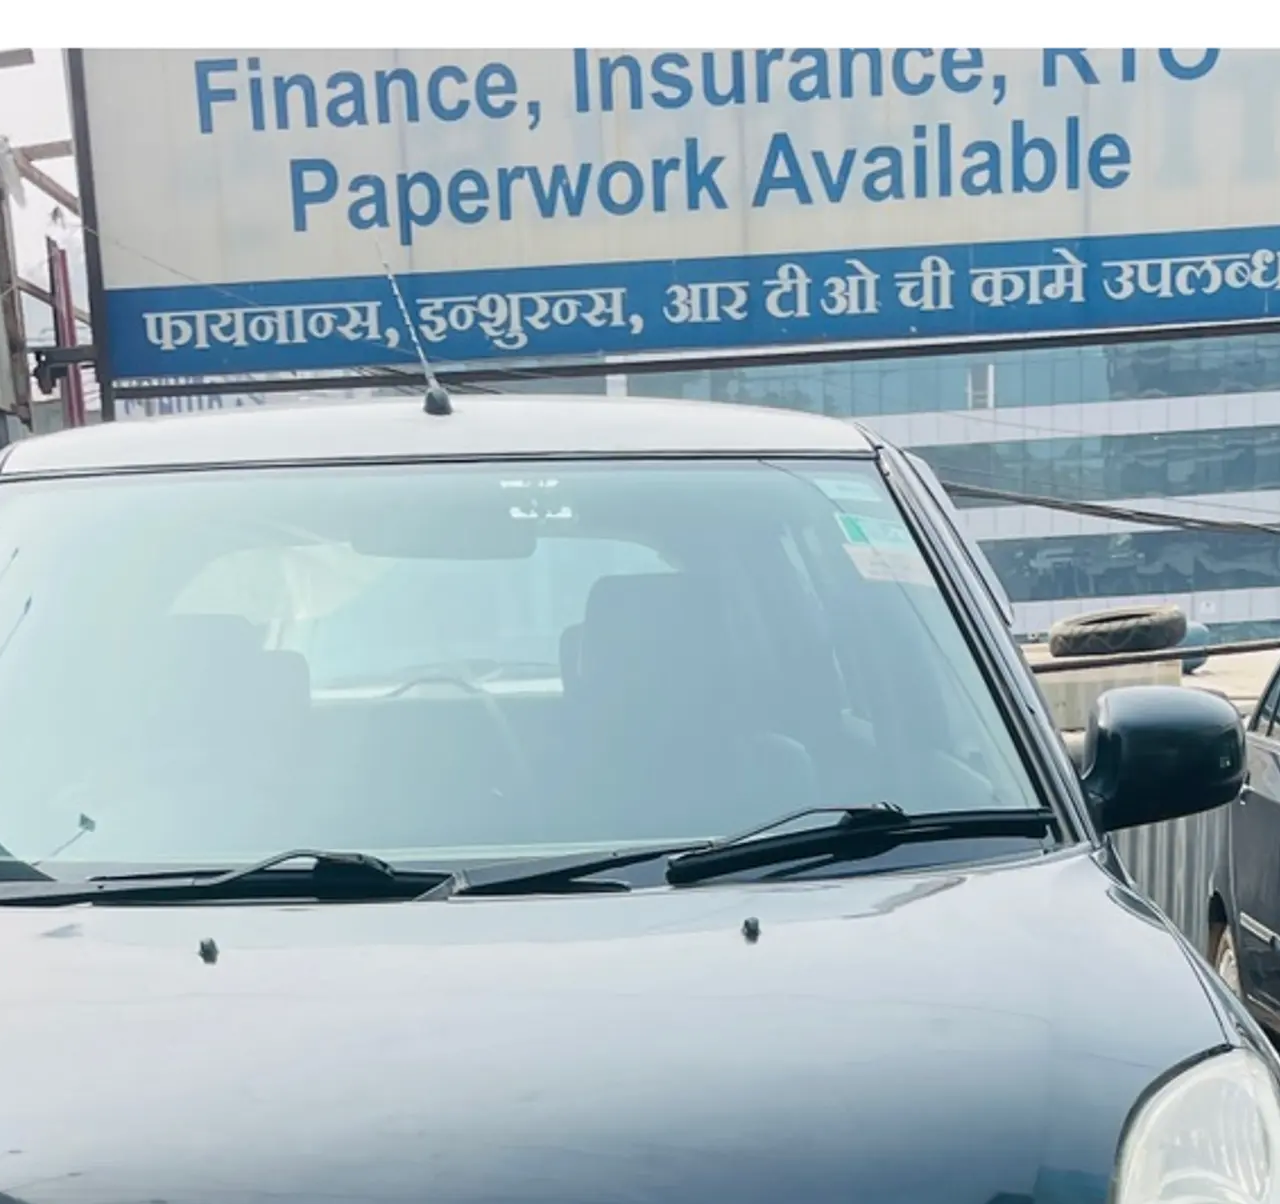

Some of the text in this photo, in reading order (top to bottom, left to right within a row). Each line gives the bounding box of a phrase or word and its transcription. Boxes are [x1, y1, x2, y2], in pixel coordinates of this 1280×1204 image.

[195, 59, 540, 133] Finance,
[574, 48, 1006, 113] Insurance,
[291, 138, 726, 246] Paperwork
[753, 115, 1131, 207] Available
[144, 300, 400, 350] फायनान्स,
[663, 281, 750, 323] आर
[763, 263, 812, 318] टी
[894, 255, 955, 310] ची
[969, 247, 1087, 307] कामे
